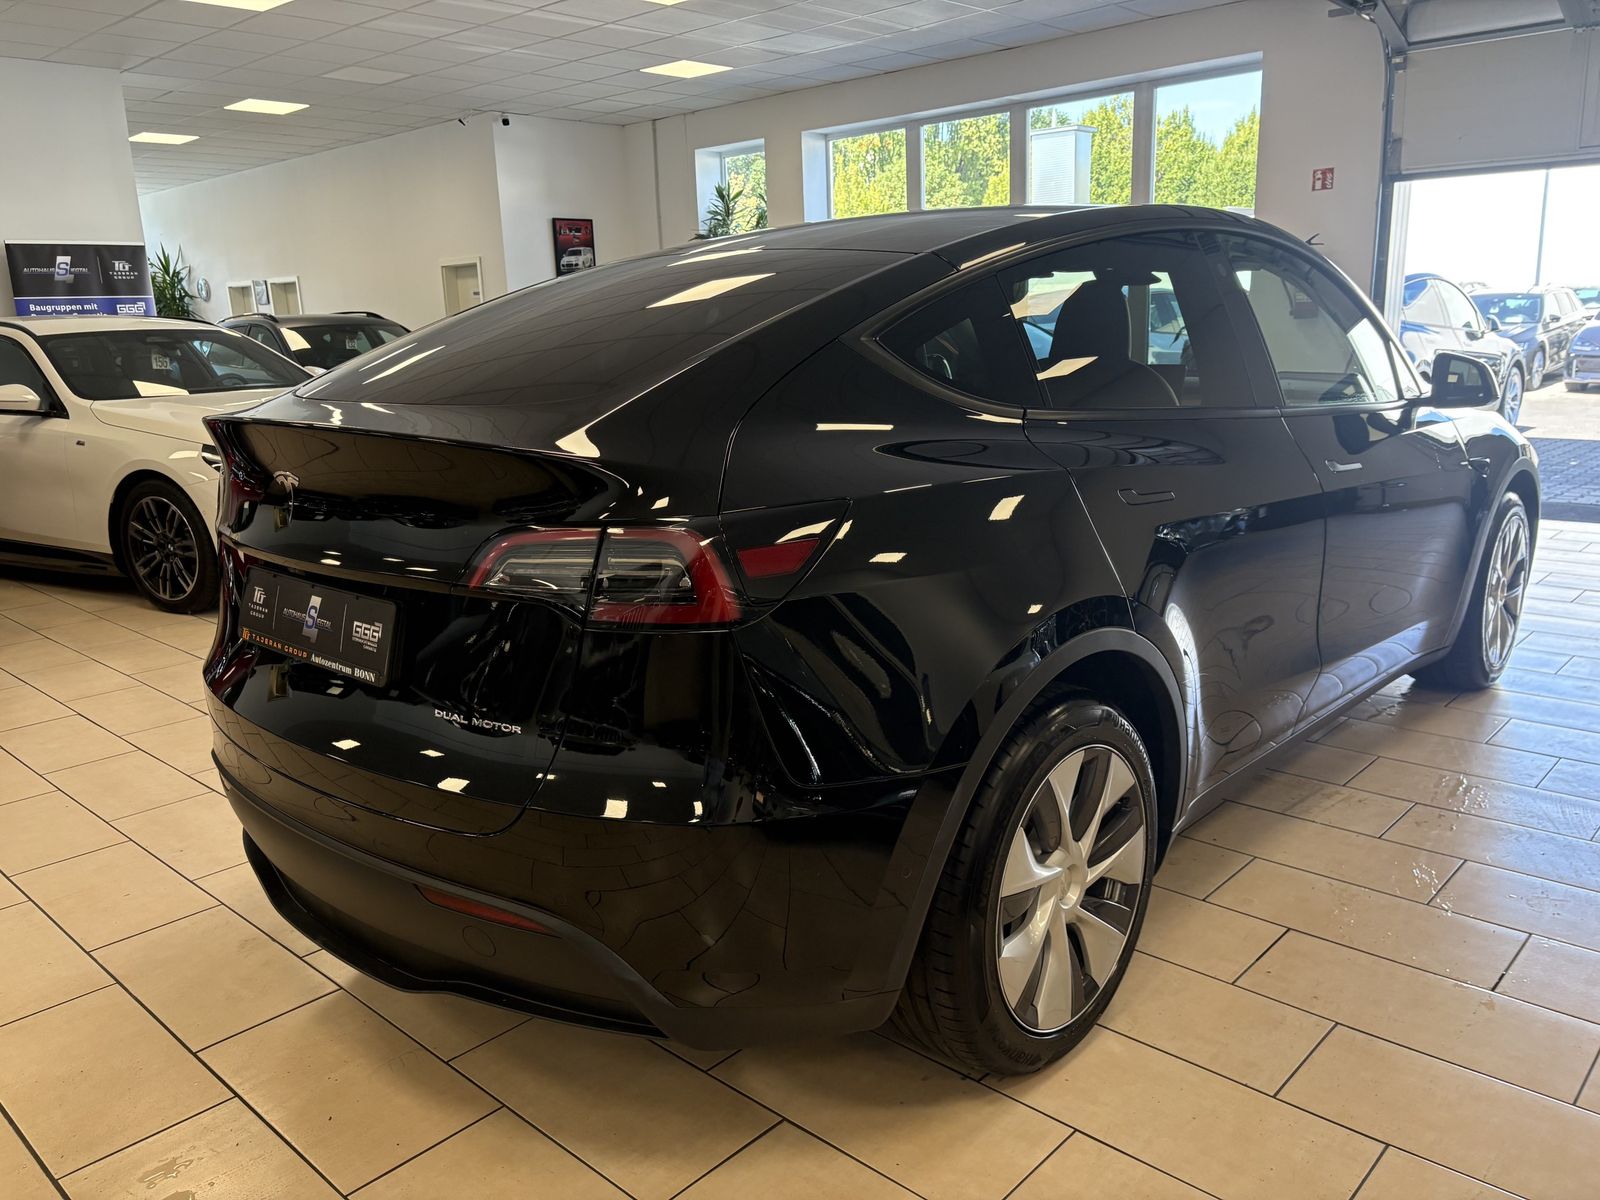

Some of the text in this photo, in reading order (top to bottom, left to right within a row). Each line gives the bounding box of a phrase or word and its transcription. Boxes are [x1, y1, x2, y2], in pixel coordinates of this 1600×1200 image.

[29, 303, 98, 313] Baugruppen mit
[116, 302, 146, 314] GGG
[352, 620, 383, 643] GGG
[284, 645, 308, 659] GROUP
[310, 653, 352, 675] Autozentrum
[354, 667, 376, 683] BONN
[434, 708, 522, 735] DUAL MOTOR
